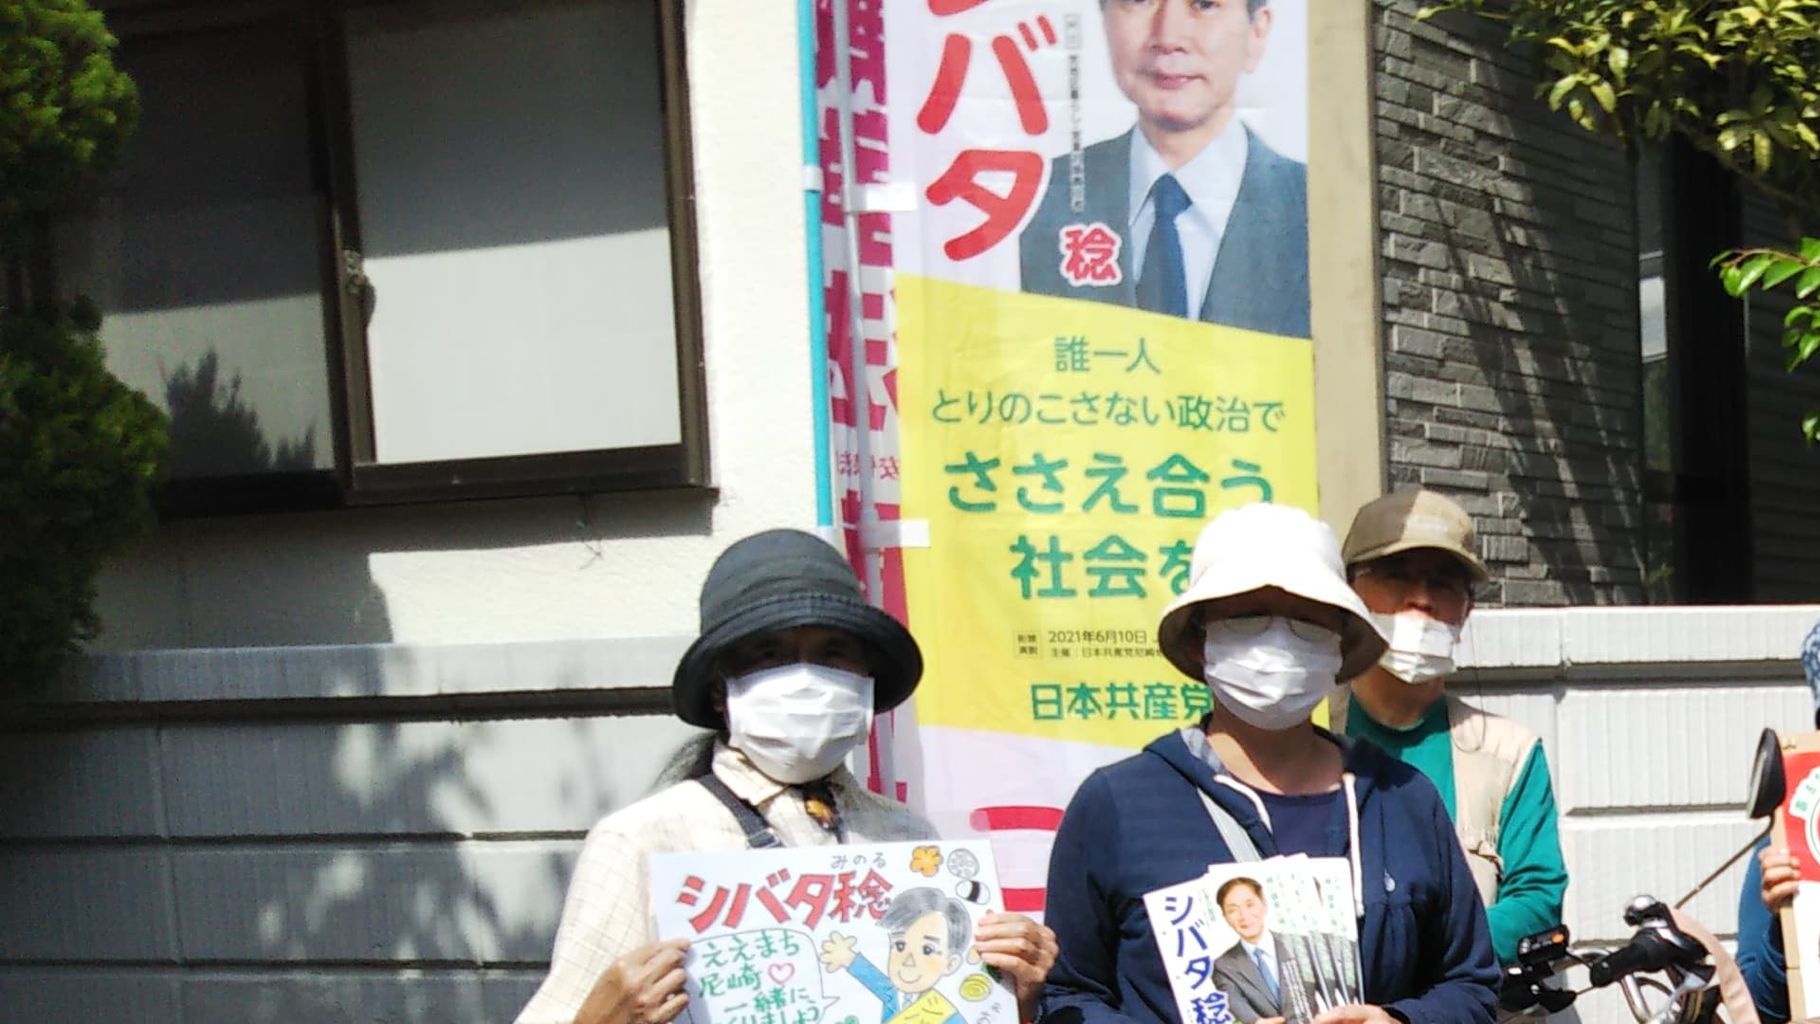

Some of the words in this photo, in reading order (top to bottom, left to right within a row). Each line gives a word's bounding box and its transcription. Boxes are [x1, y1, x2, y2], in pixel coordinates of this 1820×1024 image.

[917, 0, 1057, 262] バタ
[1054, 335, 1162, 373] 誰一人
[931, 388, 1286, 433] とりのこさない政治で
[944, 451, 1273, 519] ささえ合う
[1031, 682, 1213, 721] 日本共産党
[831, 852, 887, 870] みのる
[676, 867, 895, 935] シバタ稔
[702, 929, 800, 968] ええまち
[699, 962, 762, 998] 尼崎
